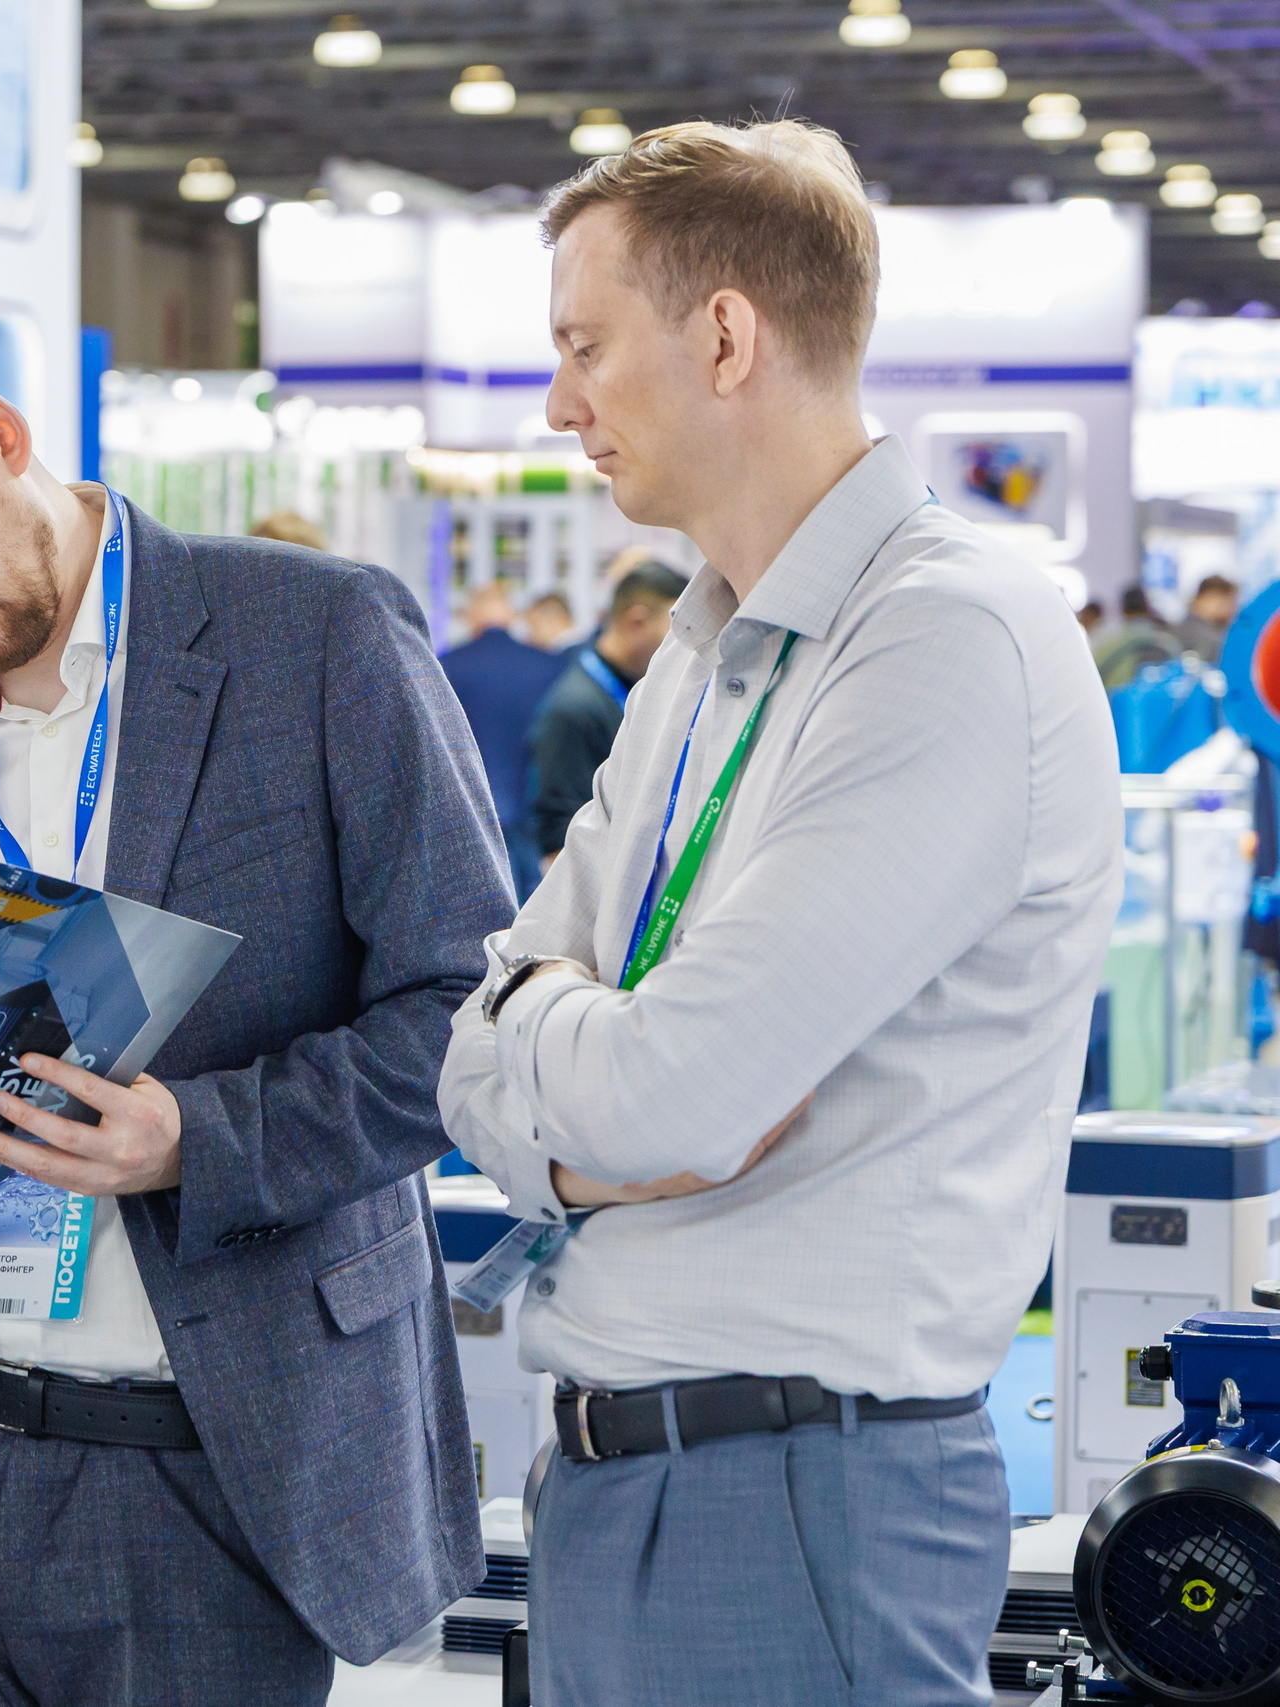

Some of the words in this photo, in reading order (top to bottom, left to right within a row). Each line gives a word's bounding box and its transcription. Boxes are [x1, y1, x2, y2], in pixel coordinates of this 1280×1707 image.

[109, 602, 117, 655] ЭКВАТЭК
[86, 724, 103, 789] ECWATECH
[637, 914, 669, 971] ЭКВАТЭК
